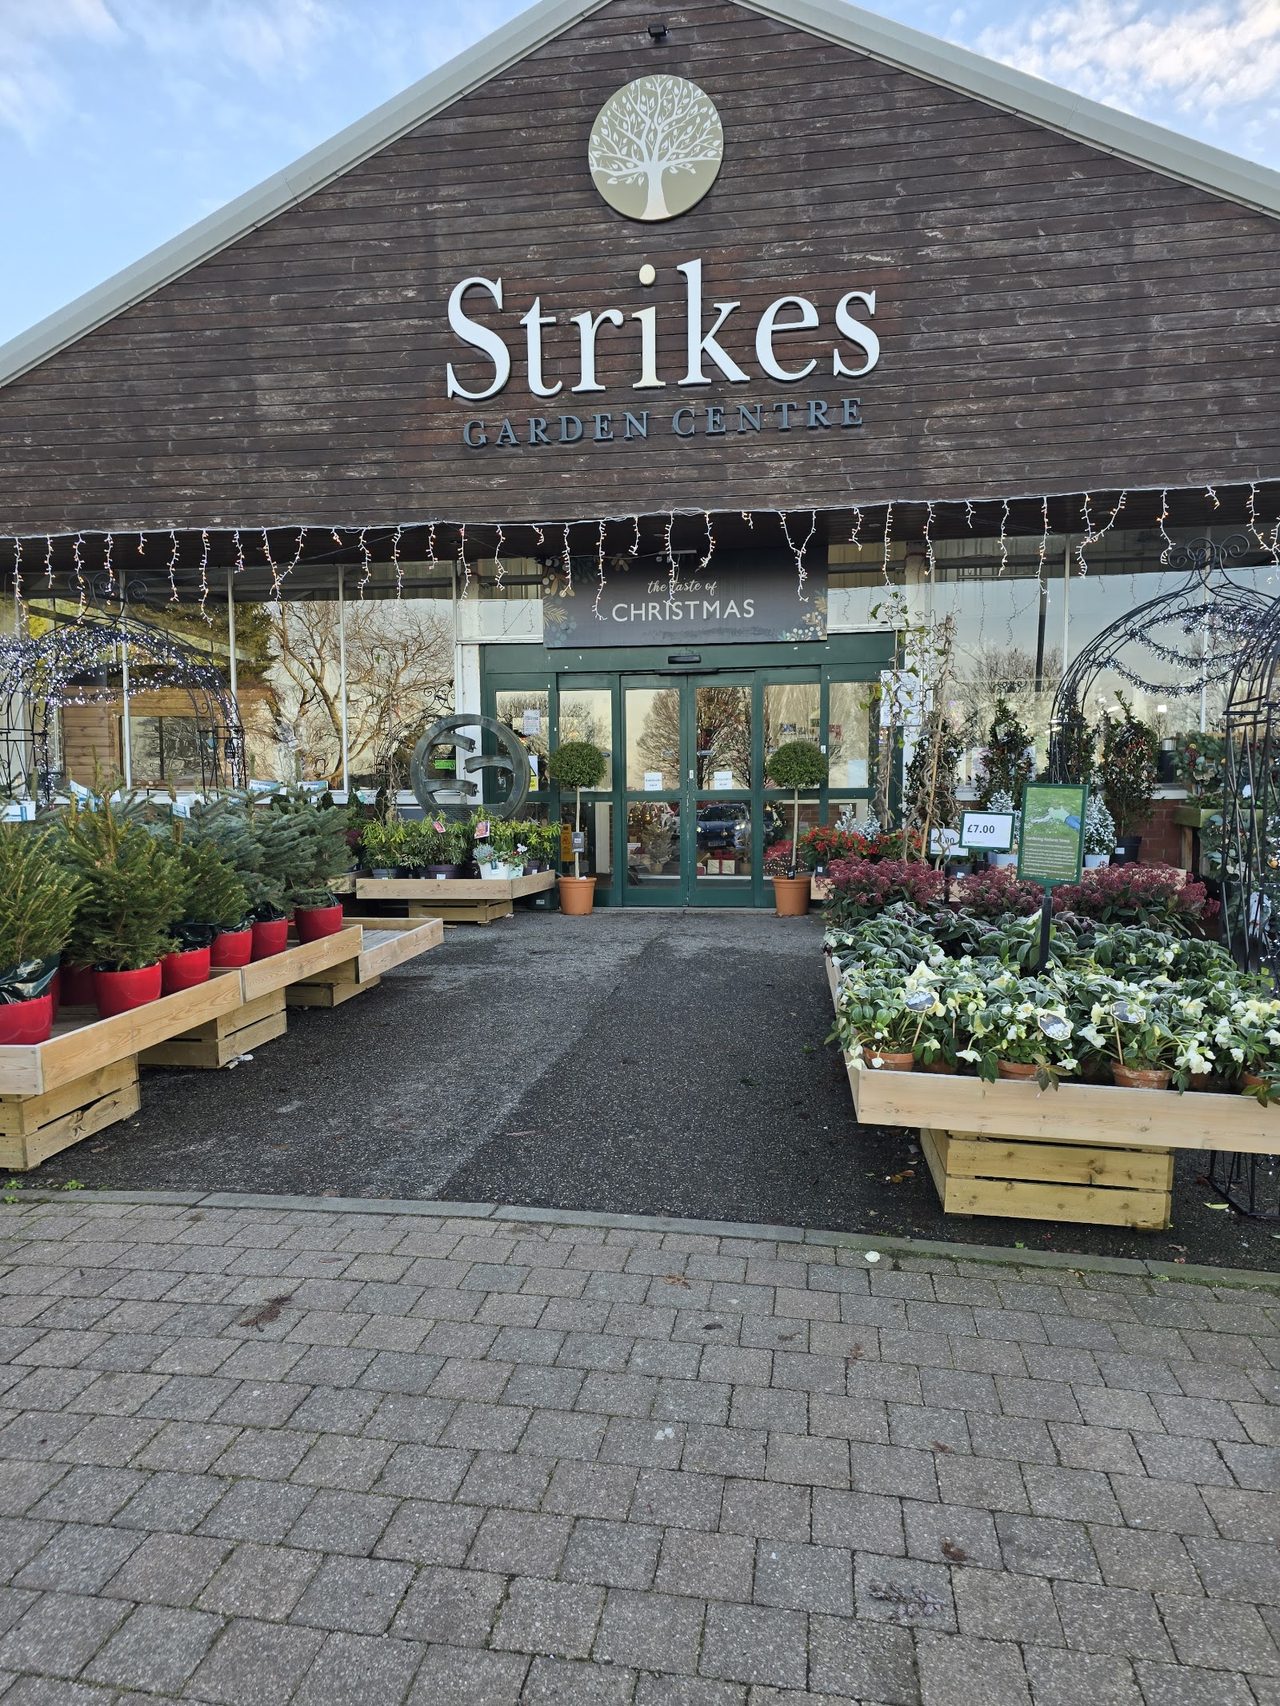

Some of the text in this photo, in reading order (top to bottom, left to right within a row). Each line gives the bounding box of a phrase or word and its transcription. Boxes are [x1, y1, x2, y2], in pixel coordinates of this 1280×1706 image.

[446, 257, 881, 401] Strikes
[462, 397, 865, 449] GARDEN CENTRE
[647, 579, 718, 596] the taste of
[611, 599, 755, 622] CHRISTMAS
[967, 823, 995, 834] £7.00
